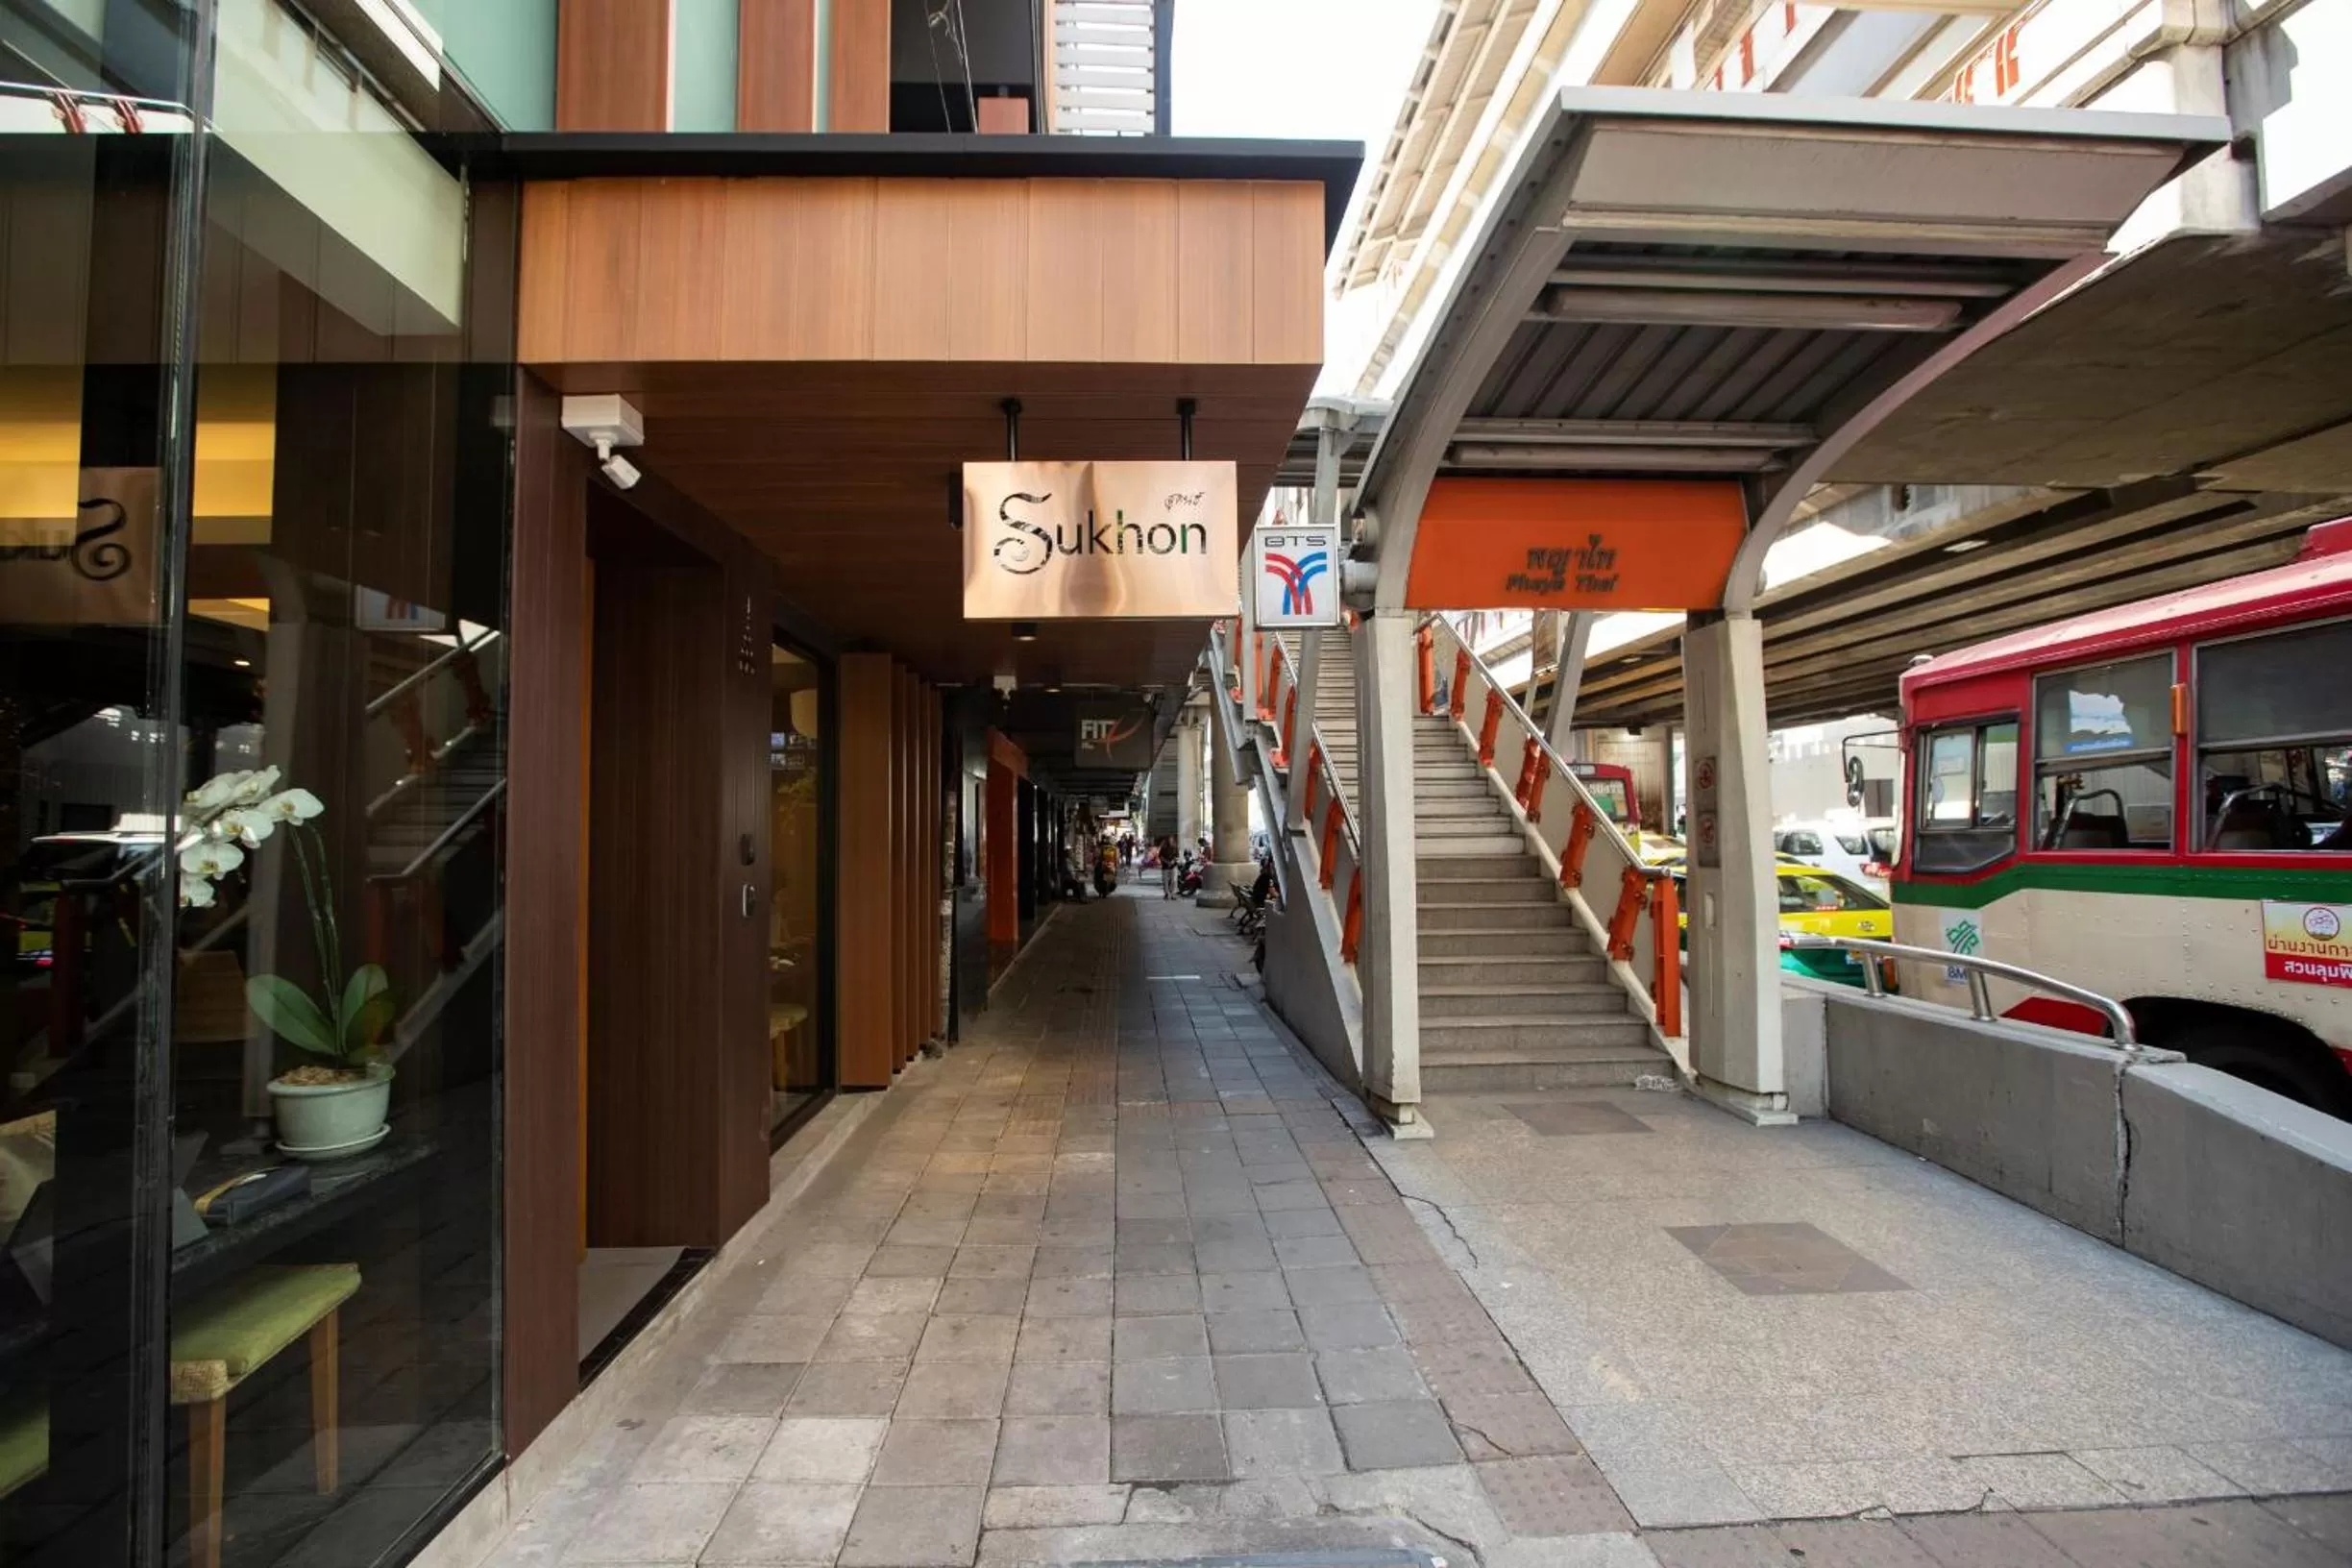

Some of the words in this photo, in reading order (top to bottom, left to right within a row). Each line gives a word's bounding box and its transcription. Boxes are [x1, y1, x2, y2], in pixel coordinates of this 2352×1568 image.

[993, 491, 1207, 575] Sukhon
[1263, 534, 1327, 548] BTS
[1575, 573, 1620, 593] Thai
[2267, 933, 2352, 958] ผ่านงานกา
